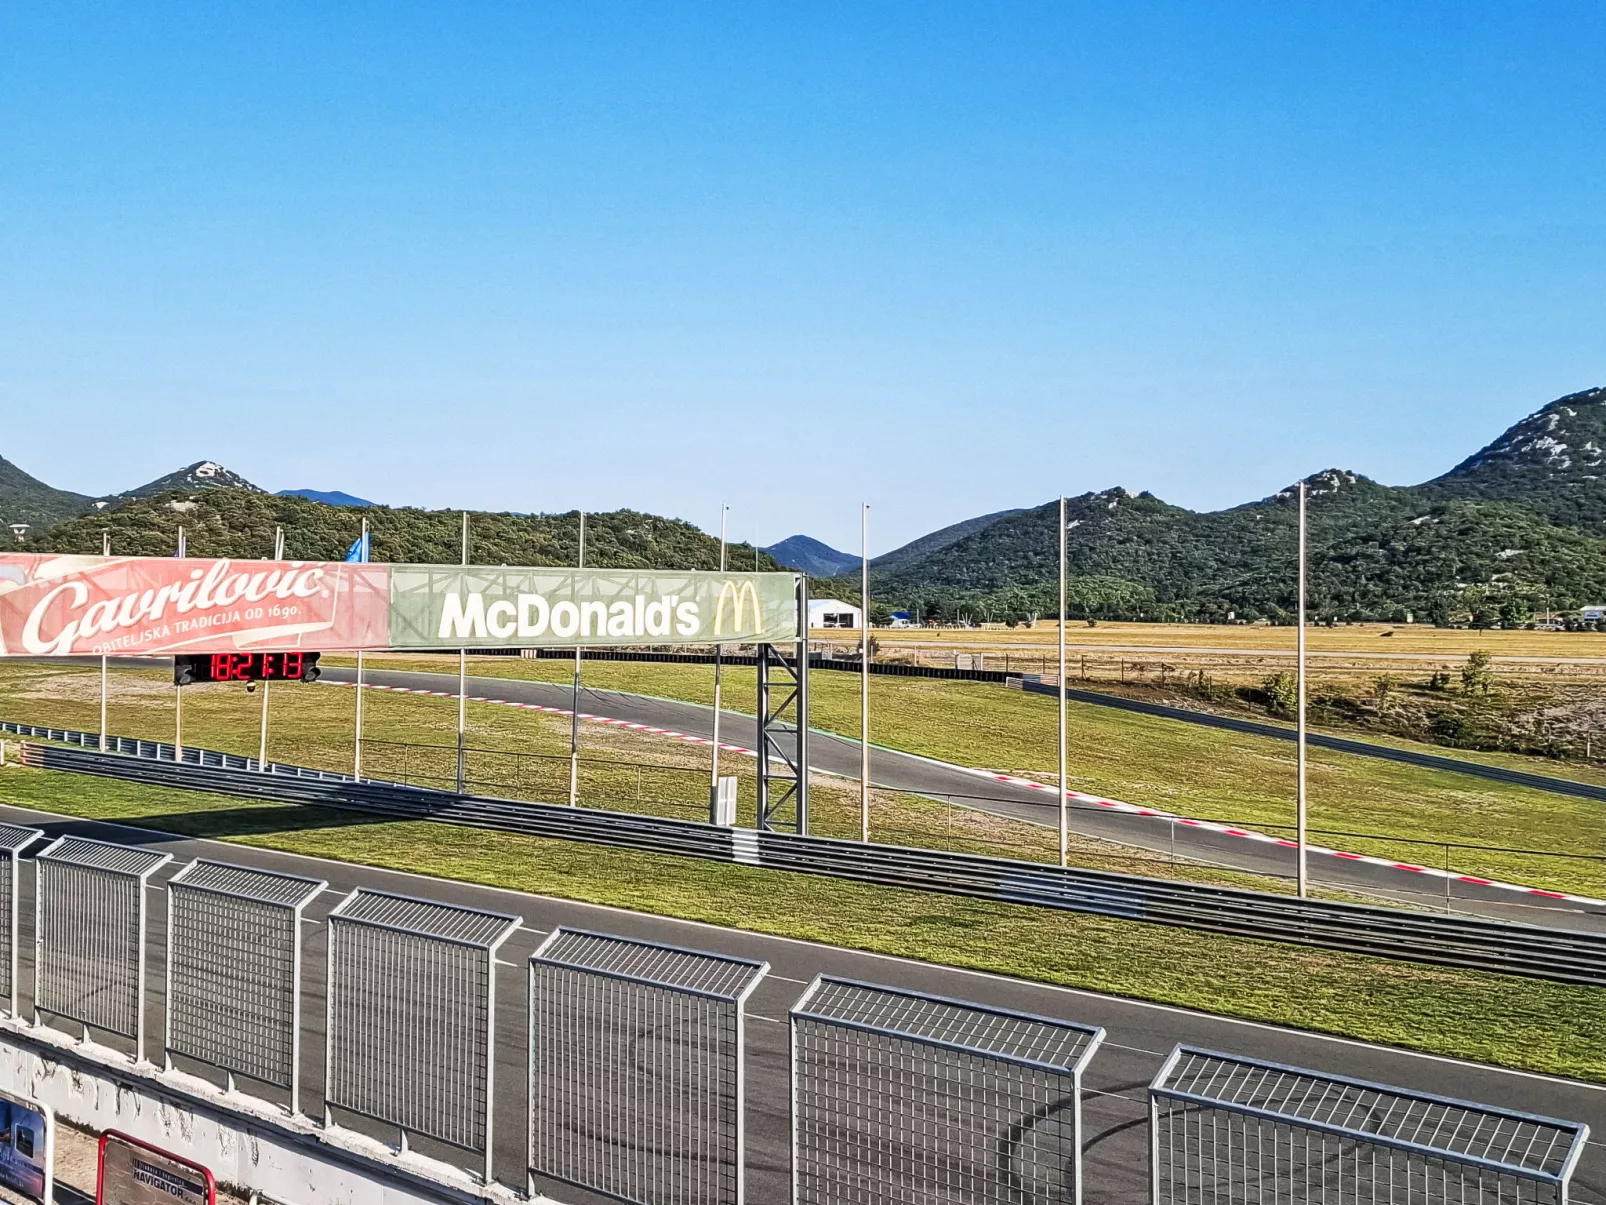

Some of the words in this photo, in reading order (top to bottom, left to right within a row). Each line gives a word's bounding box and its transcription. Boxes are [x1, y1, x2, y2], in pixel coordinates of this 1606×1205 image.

[22, 558, 325, 655] Gavrilović
[438, 593, 700, 638] McDonald's
[92, 625, 171, 655] OBITELJSKA
[175, 609, 241, 634] TRADICIJA
[245, 607, 263, 620] OD
[133, 1169, 184, 1200] NAVIGATOR
